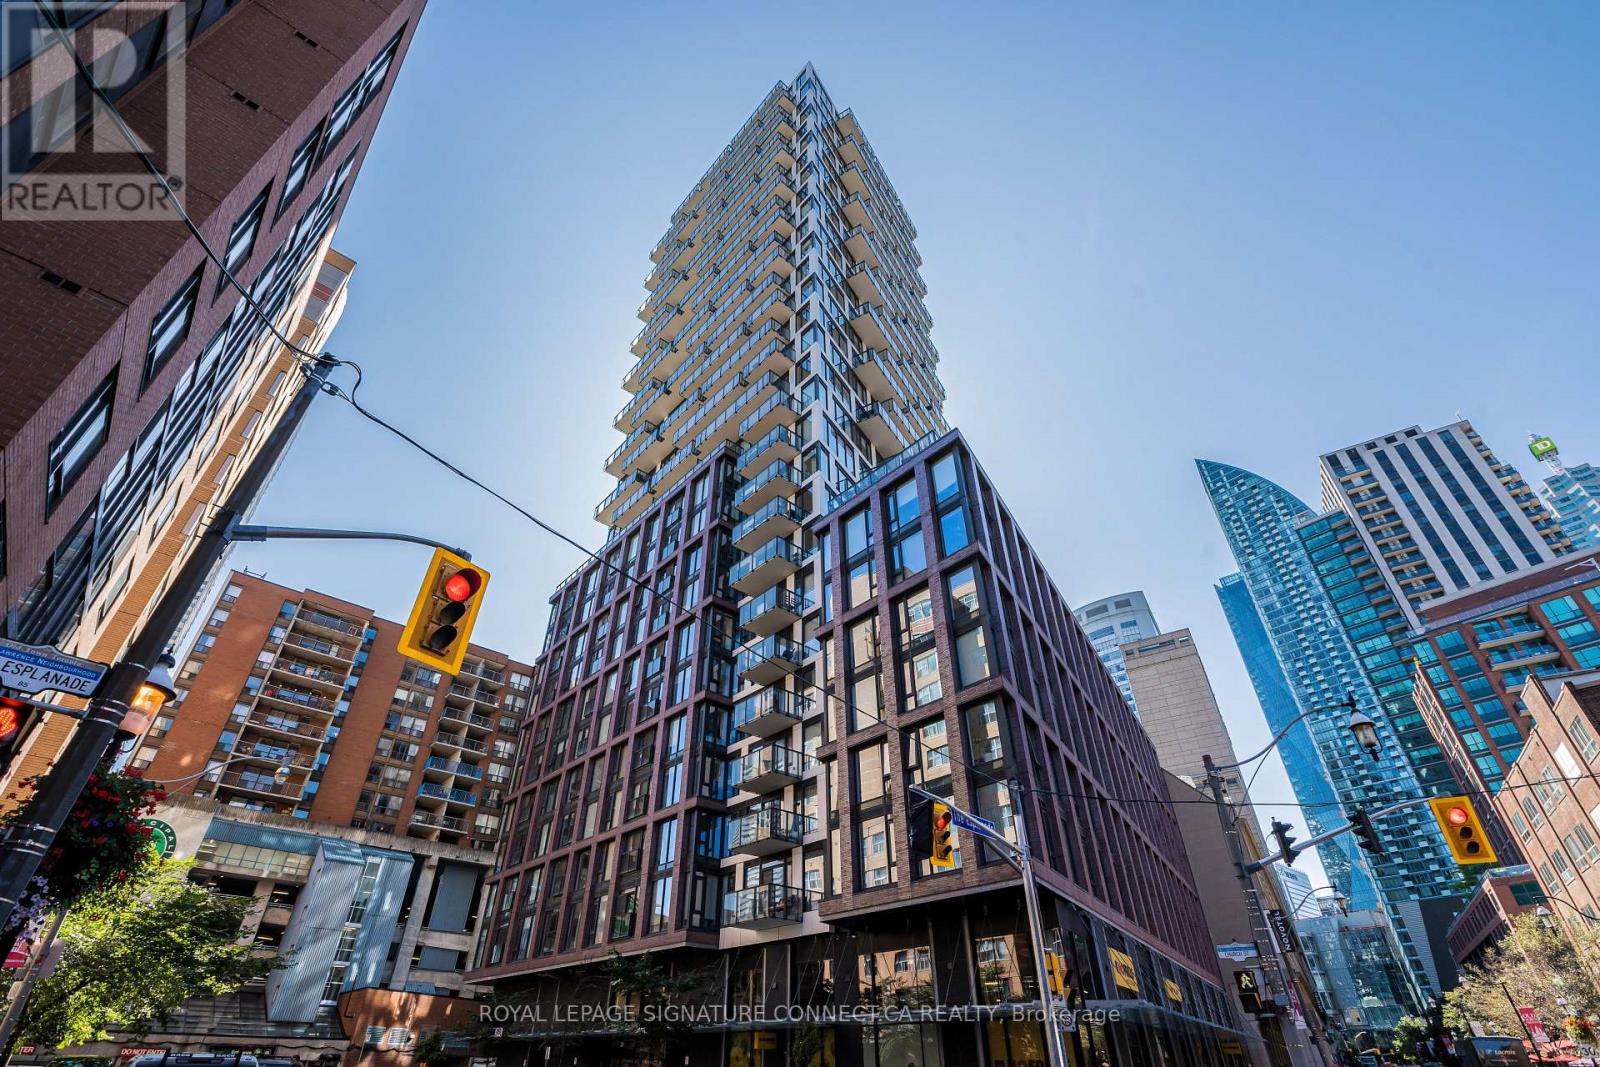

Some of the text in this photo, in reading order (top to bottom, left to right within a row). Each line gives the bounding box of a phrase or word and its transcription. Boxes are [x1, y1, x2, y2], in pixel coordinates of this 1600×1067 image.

[1532, 440, 1551, 451] TD
[1, 660, 91, 693] ESPLANADE
[37, 657, 96, 679] NEIGHBOURHOOD
[1274, 911, 1292, 951] NOVOTEL
